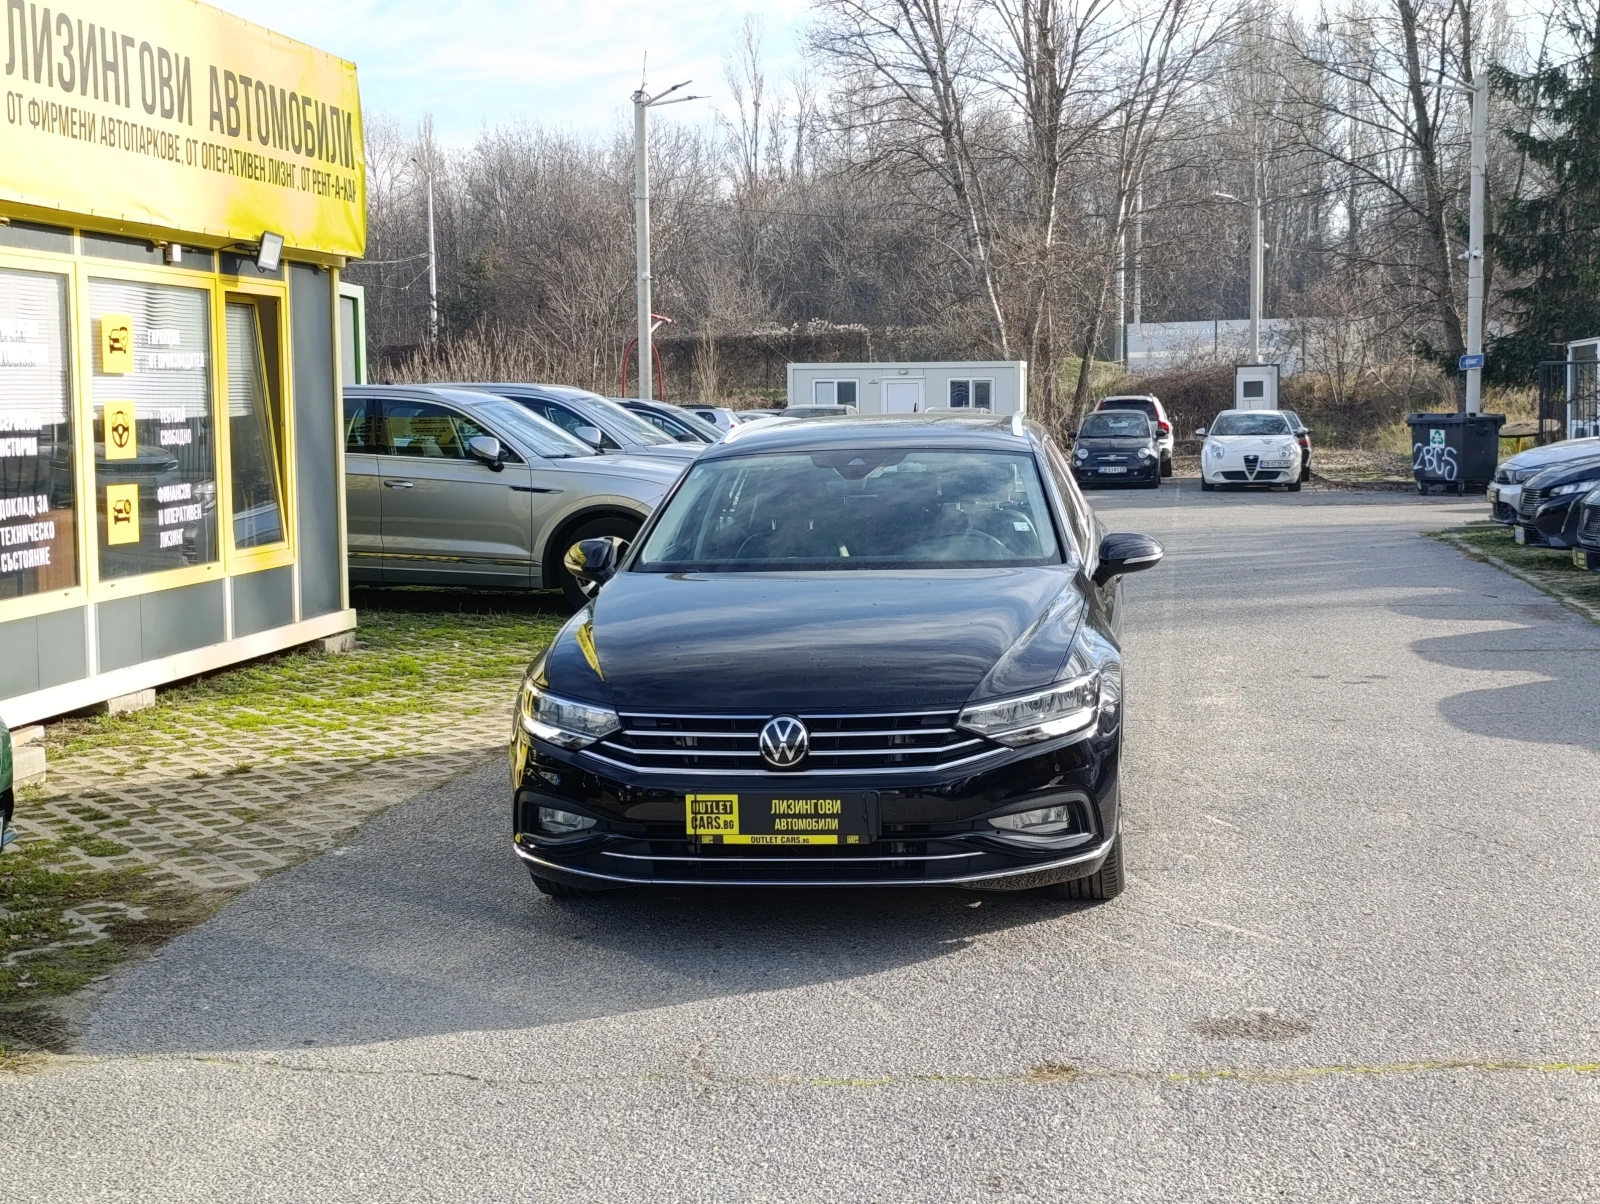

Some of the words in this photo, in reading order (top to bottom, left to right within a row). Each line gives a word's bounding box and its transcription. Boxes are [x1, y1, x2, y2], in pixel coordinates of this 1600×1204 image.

[6, 0, 193, 126] ЛИЗИНГОВИ
[209, 65, 356, 171] АВТОМОБИЛИ
[6, 90, 24, 126] ОТ
[28, 97, 97, 144] ФИРМЕНИ
[99, 115, 184, 168] АВТОПАРКОВЕ,
[186, 137, 199, 168] ОТ
[201, 141, 266, 183] ОПЕРАТИВЕН
[301, 166, 311, 192] ОТ
[160, 428, 192, 446] СВОБОДНО
[157, 483, 192, 504] ФИНАНСОВ
[0, 495, 36, 520] ДОКЛАД
[36, 494, 49, 514] ЗА
[158, 509, 164, 526] И
[164, 503, 203, 525] ОПЕРАТИВЕН
[0, 520, 56, 547] ТЕХНИЧЕСКО
[160, 528, 185, 549] ЛИЗИНГ
[1, 546, 51, 573] СЪСТОЯНИЕ
[692, 801, 732, 813] OUTLET
[770, 799, 842, 814] ЛИЗИНГОВИ
[691, 815, 735, 830] CARS.BG
[774, 818, 839, 831] АВТОМОБИЛИ
[750, 836, 778, 844] OUTLET
